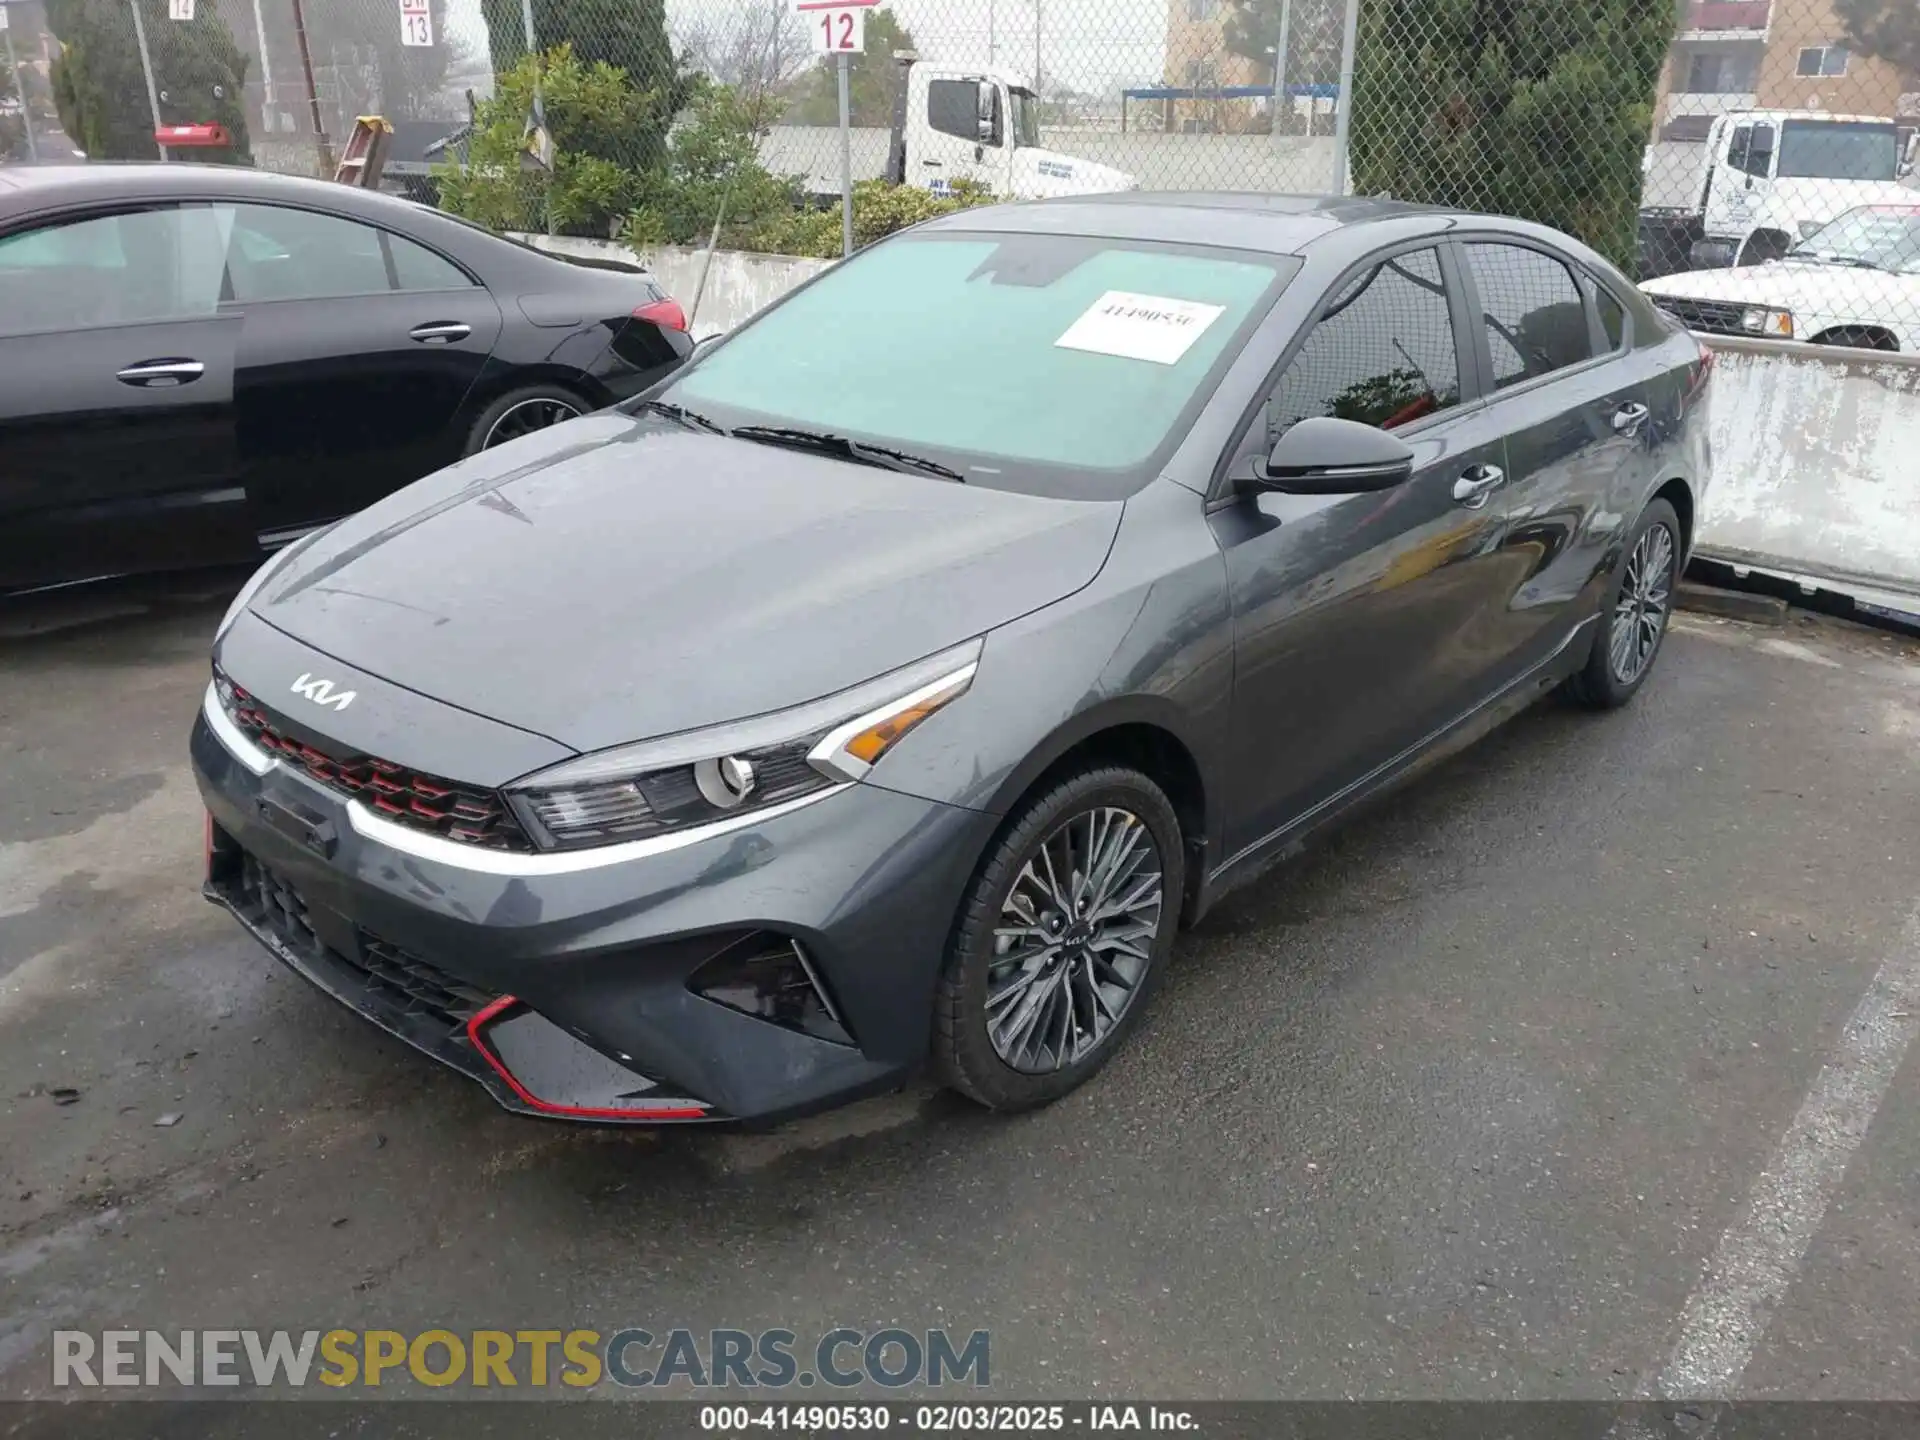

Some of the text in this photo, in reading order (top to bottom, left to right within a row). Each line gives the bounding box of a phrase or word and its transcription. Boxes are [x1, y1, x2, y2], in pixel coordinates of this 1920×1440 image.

[407, 16, 428, 43] 13
[820, 12, 855, 48] 12
[289, 672, 358, 713] KIA
